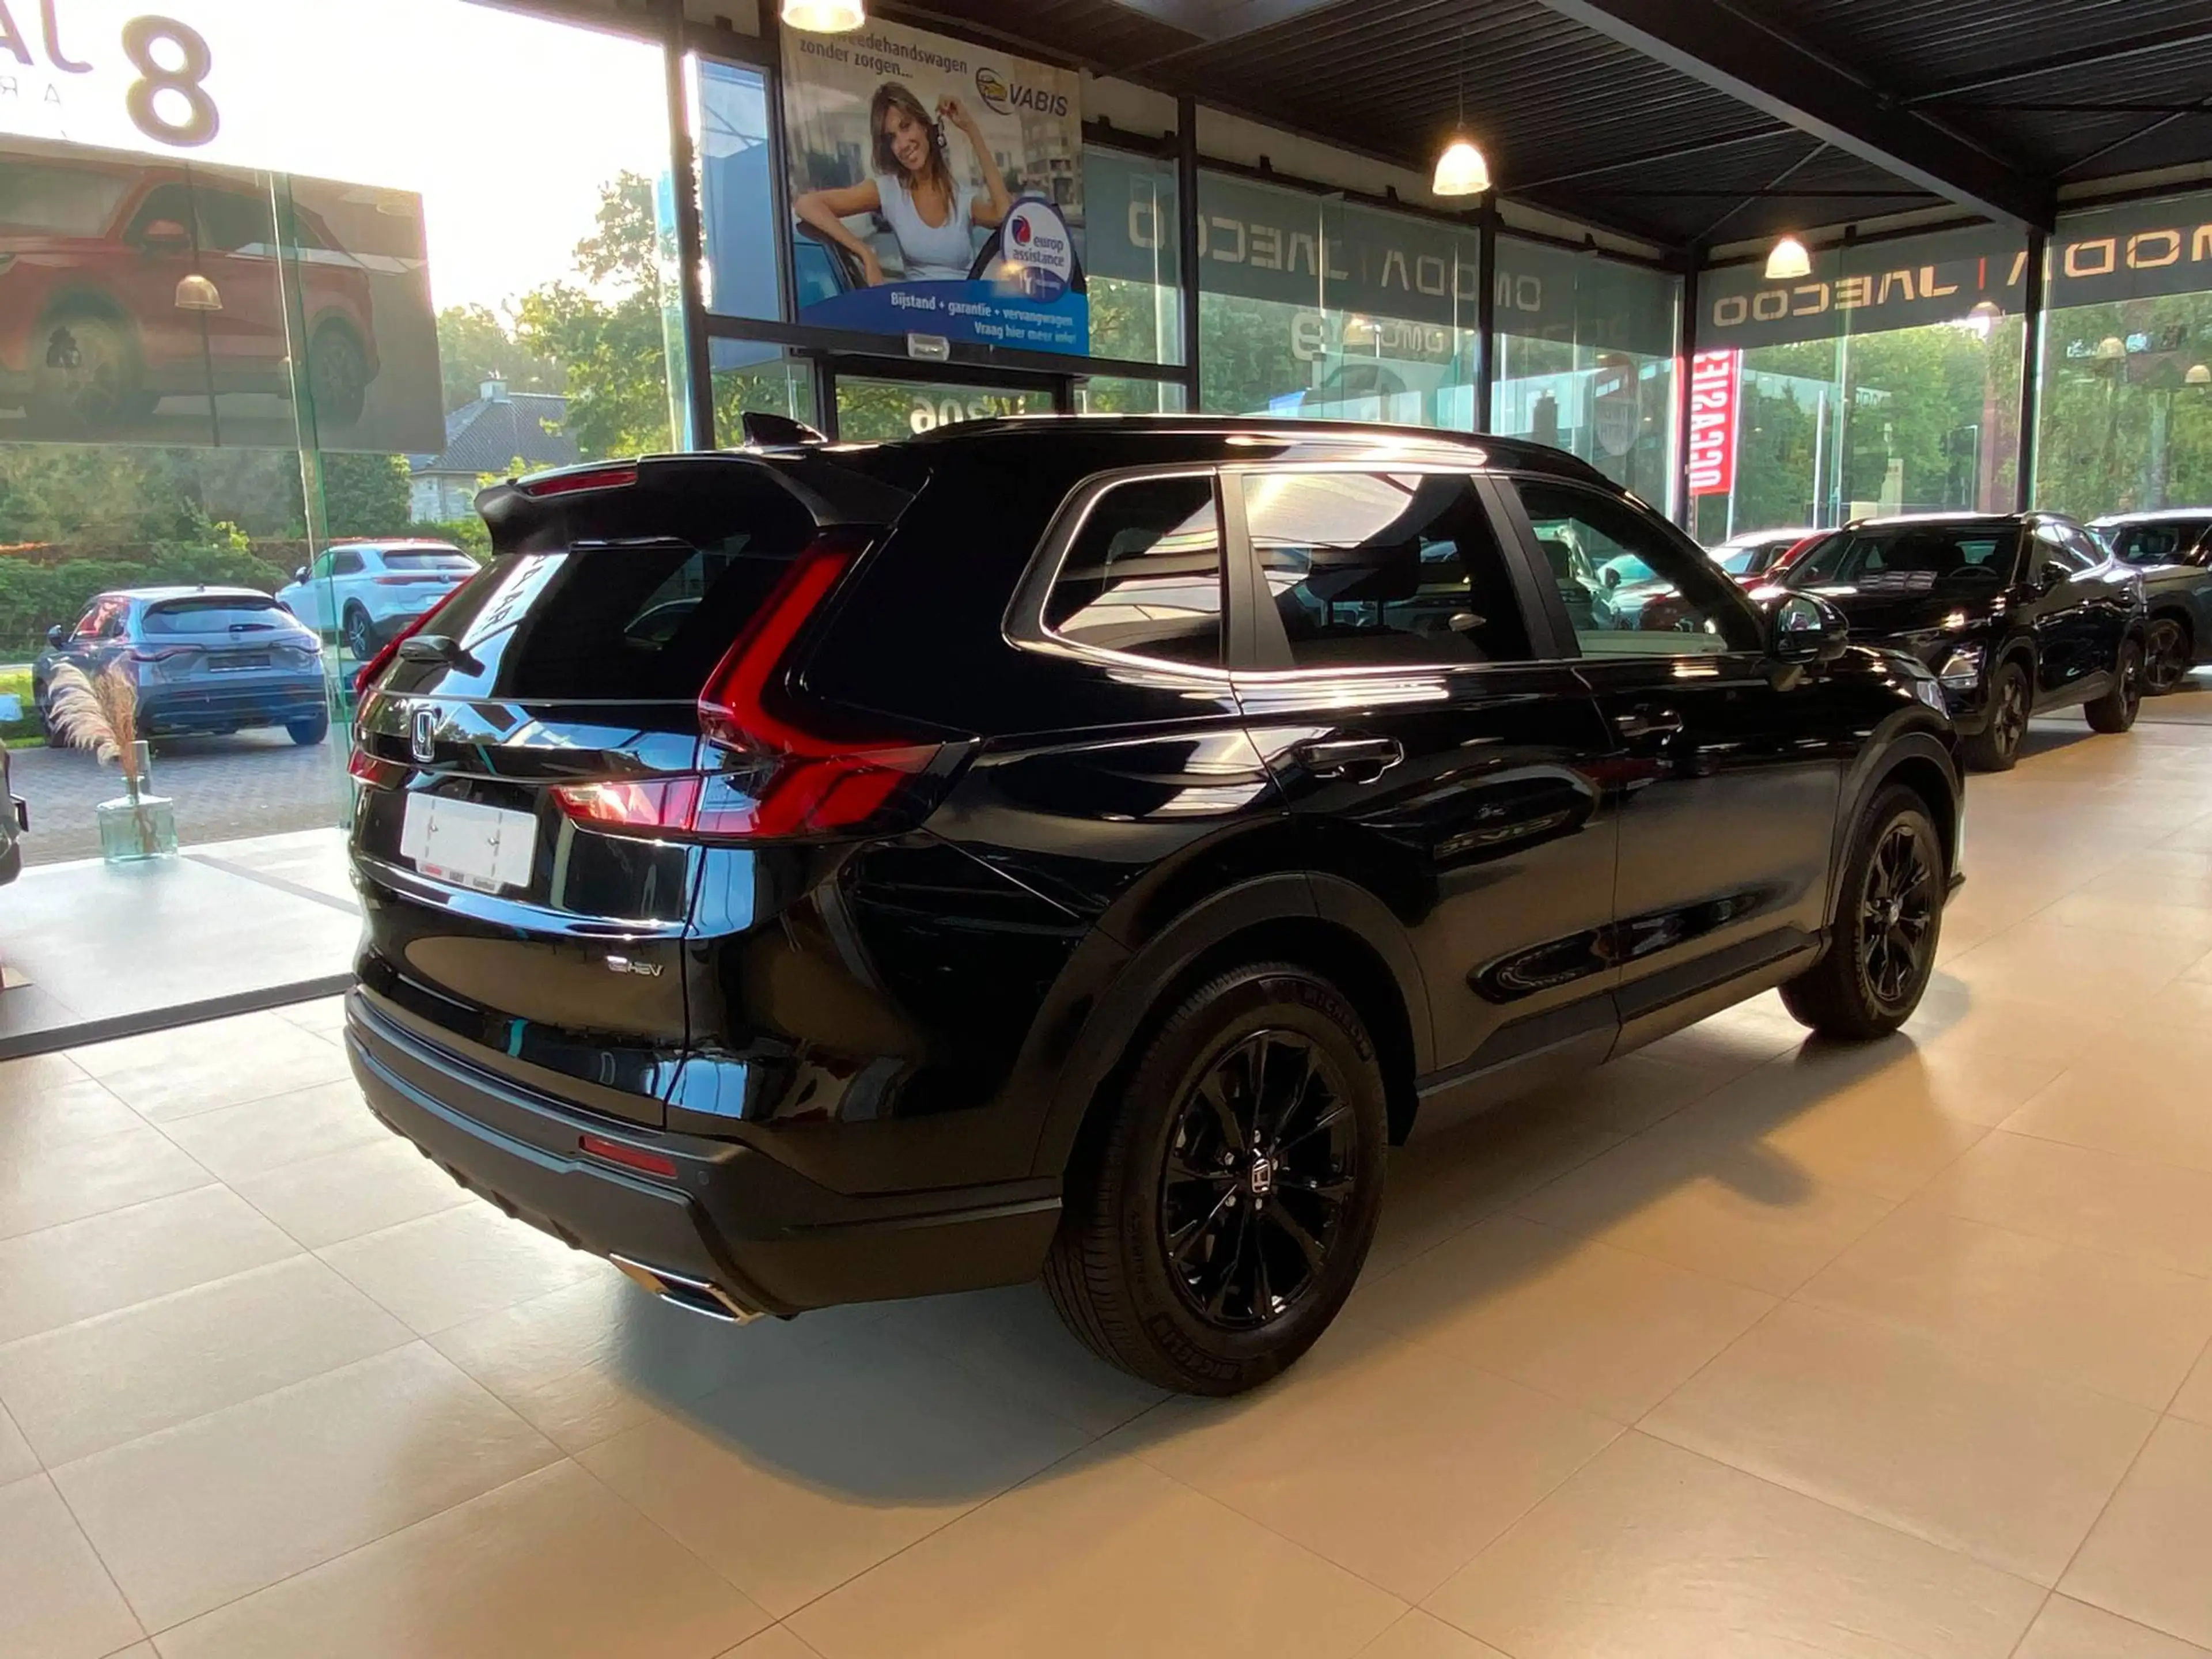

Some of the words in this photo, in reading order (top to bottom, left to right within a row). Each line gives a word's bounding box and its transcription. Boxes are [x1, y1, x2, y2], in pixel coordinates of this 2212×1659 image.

[800, 39, 849, 63] zonder
[832, 32, 967, 74] weedehandswagen
[1009, 83, 1069, 116] VABIS
[1033, 236, 1064, 253] europ
[1012, 248, 1065, 267] assistance
[891, 291, 936, 309] Bijstand
[948, 301, 992, 317] garantie
[974, 321, 1003, 340] Vraag
[1005, 324, 1025, 339] hier
